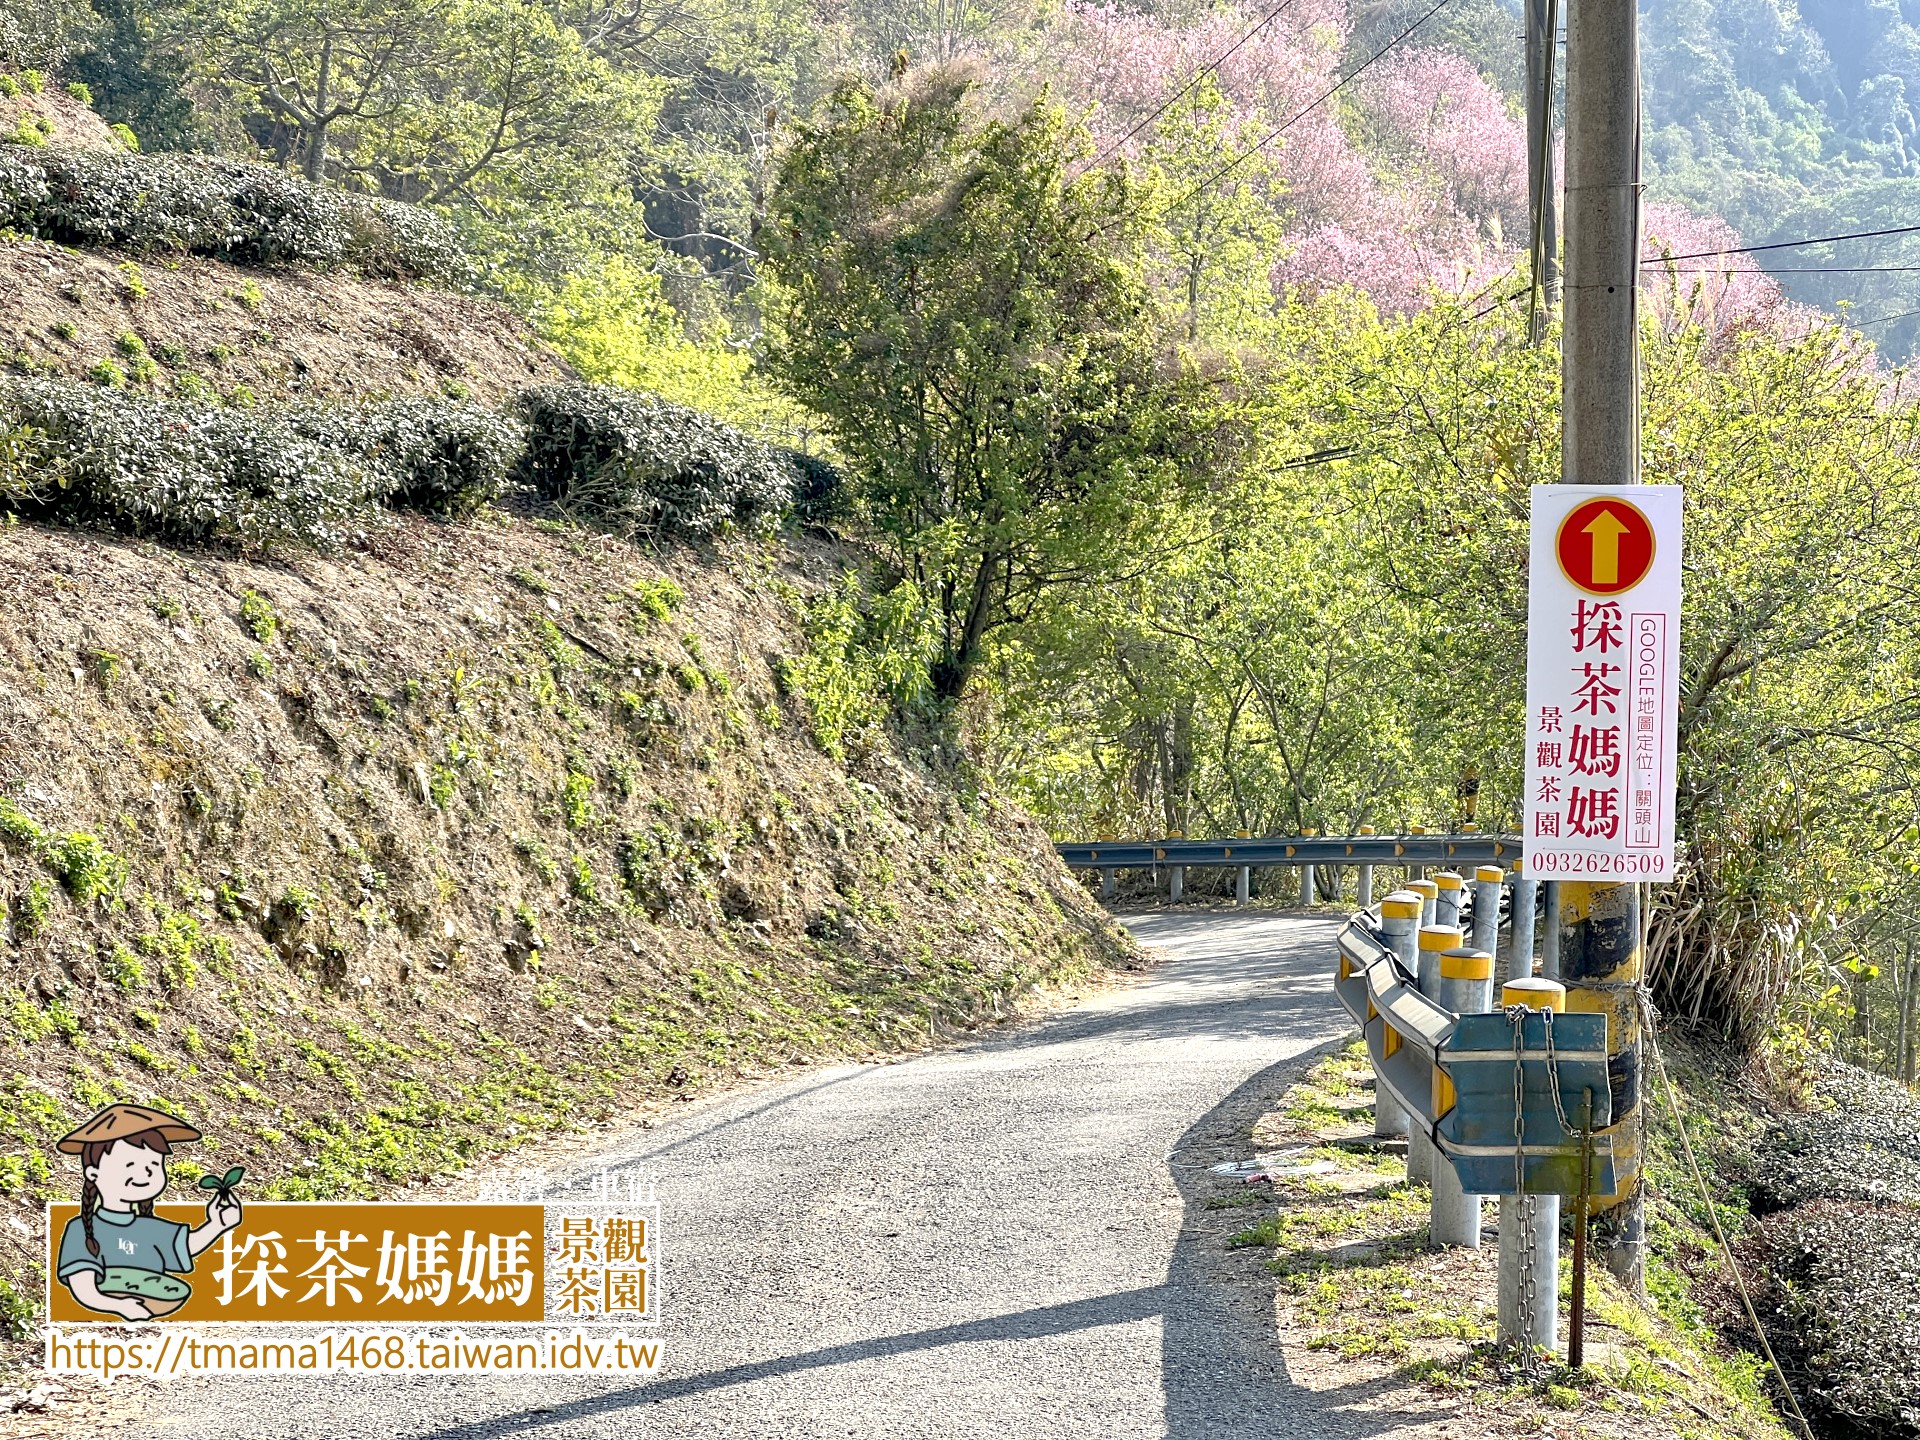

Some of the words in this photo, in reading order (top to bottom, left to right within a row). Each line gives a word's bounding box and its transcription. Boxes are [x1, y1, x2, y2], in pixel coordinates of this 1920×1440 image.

[1534, 706, 1563, 839] 景觀茶園
[1566, 599, 1623, 841] 採茶媽媽
[1532, 852, 1665, 874] 0932626509
